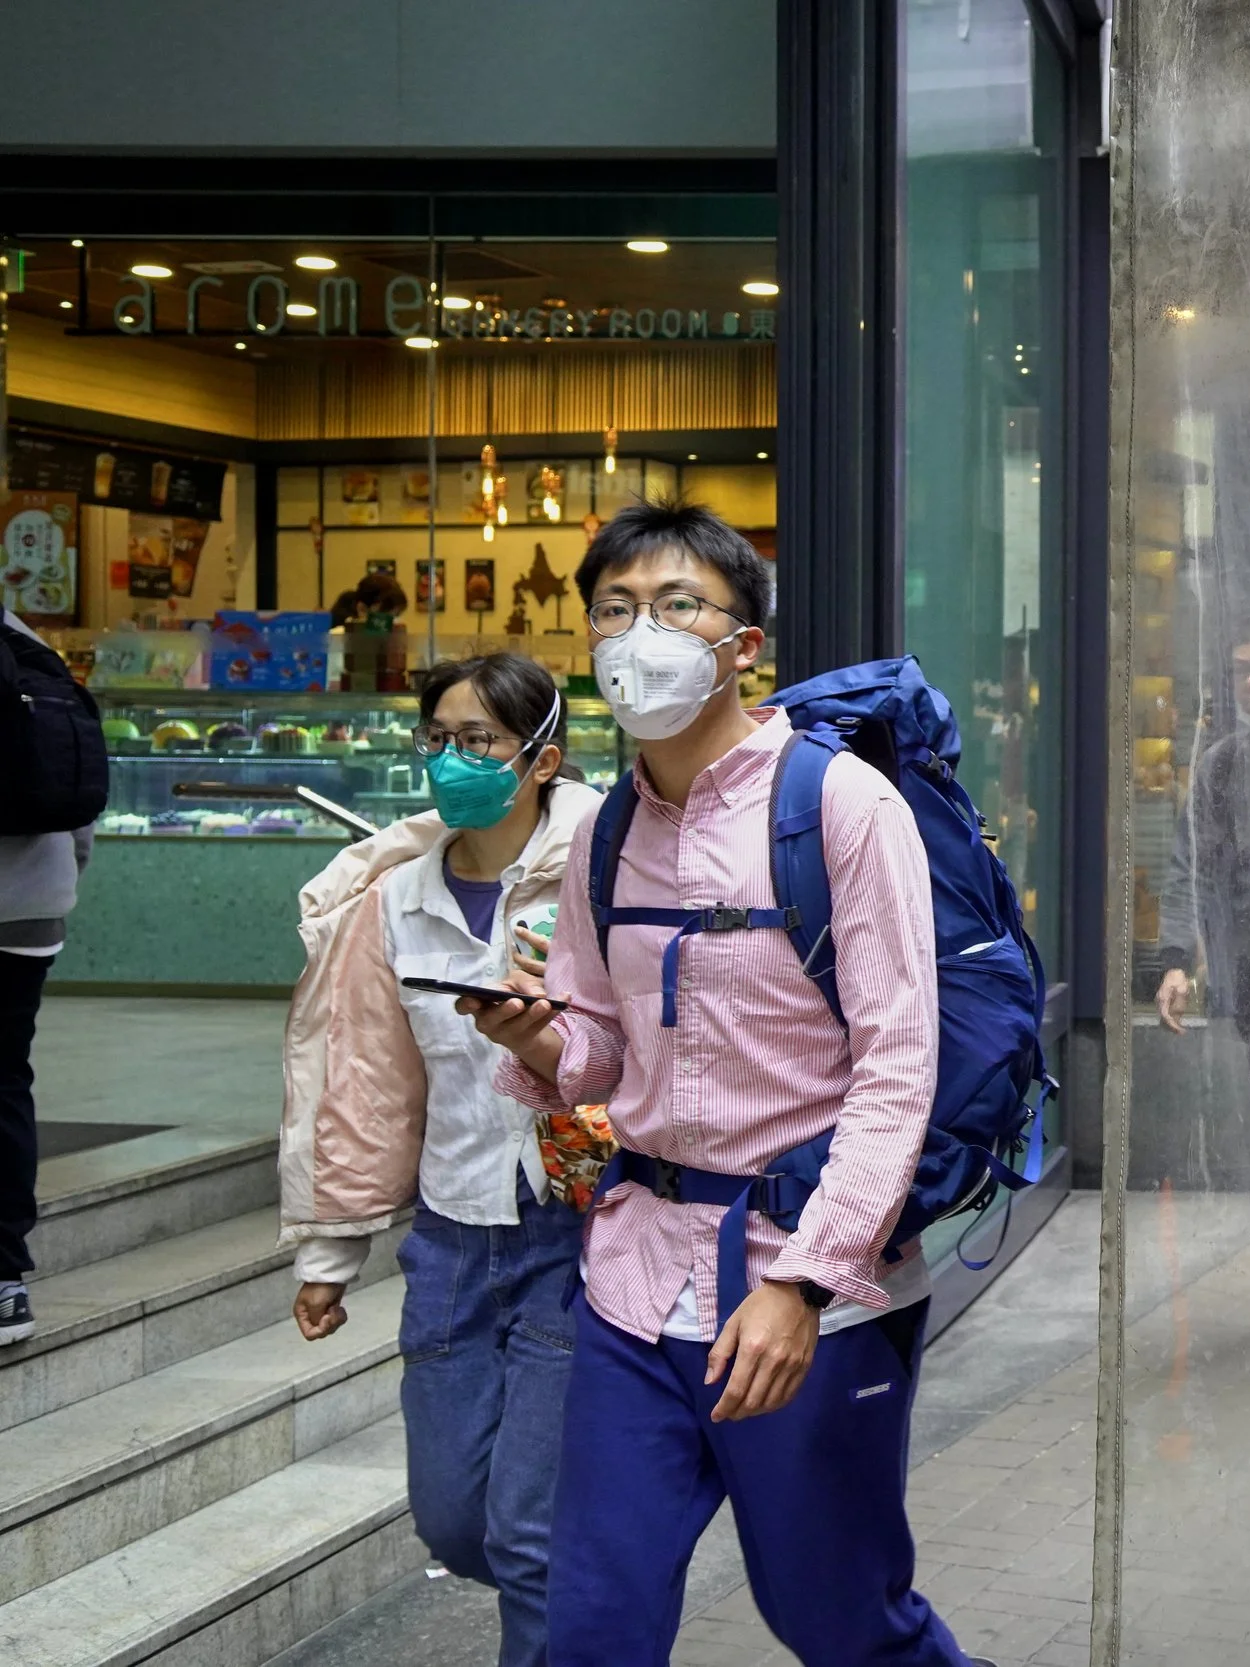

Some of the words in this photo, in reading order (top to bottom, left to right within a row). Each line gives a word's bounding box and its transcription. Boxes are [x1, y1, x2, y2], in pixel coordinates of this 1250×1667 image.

[113, 274, 425, 337] arome
[608, 308, 709, 339] ROOM
[750, 309, 777, 339] 東
